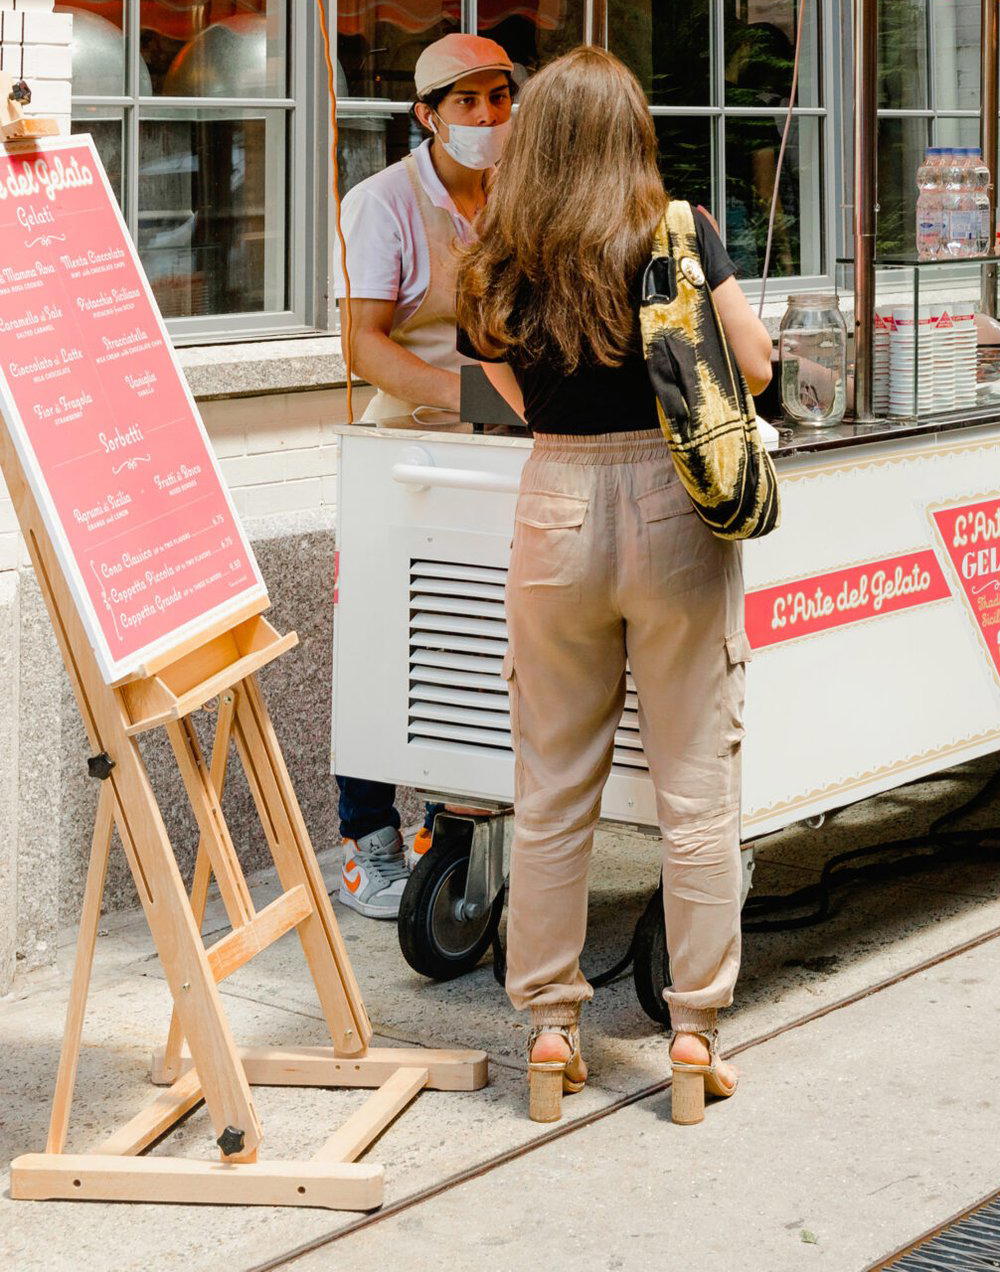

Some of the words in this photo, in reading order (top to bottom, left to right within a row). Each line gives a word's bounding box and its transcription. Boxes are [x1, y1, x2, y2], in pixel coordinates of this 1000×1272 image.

[6, 160, 40, 197] del
[34, 155, 94, 201] Gelato
[16, 204, 56, 232] Gelati
[98, 423, 144, 454] Sorbetti
[101, 563, 123, 578] Cono
[111, 578, 147, 603] Coppetta
[145, 562, 175, 586] Piccola
[120, 604, 156, 628] Coppetta
[154, 586, 182, 612] Grande
[771, 583, 835, 629] L'Arte
[836, 576, 870, 612] del
[871, 563, 931, 609] Gelato
